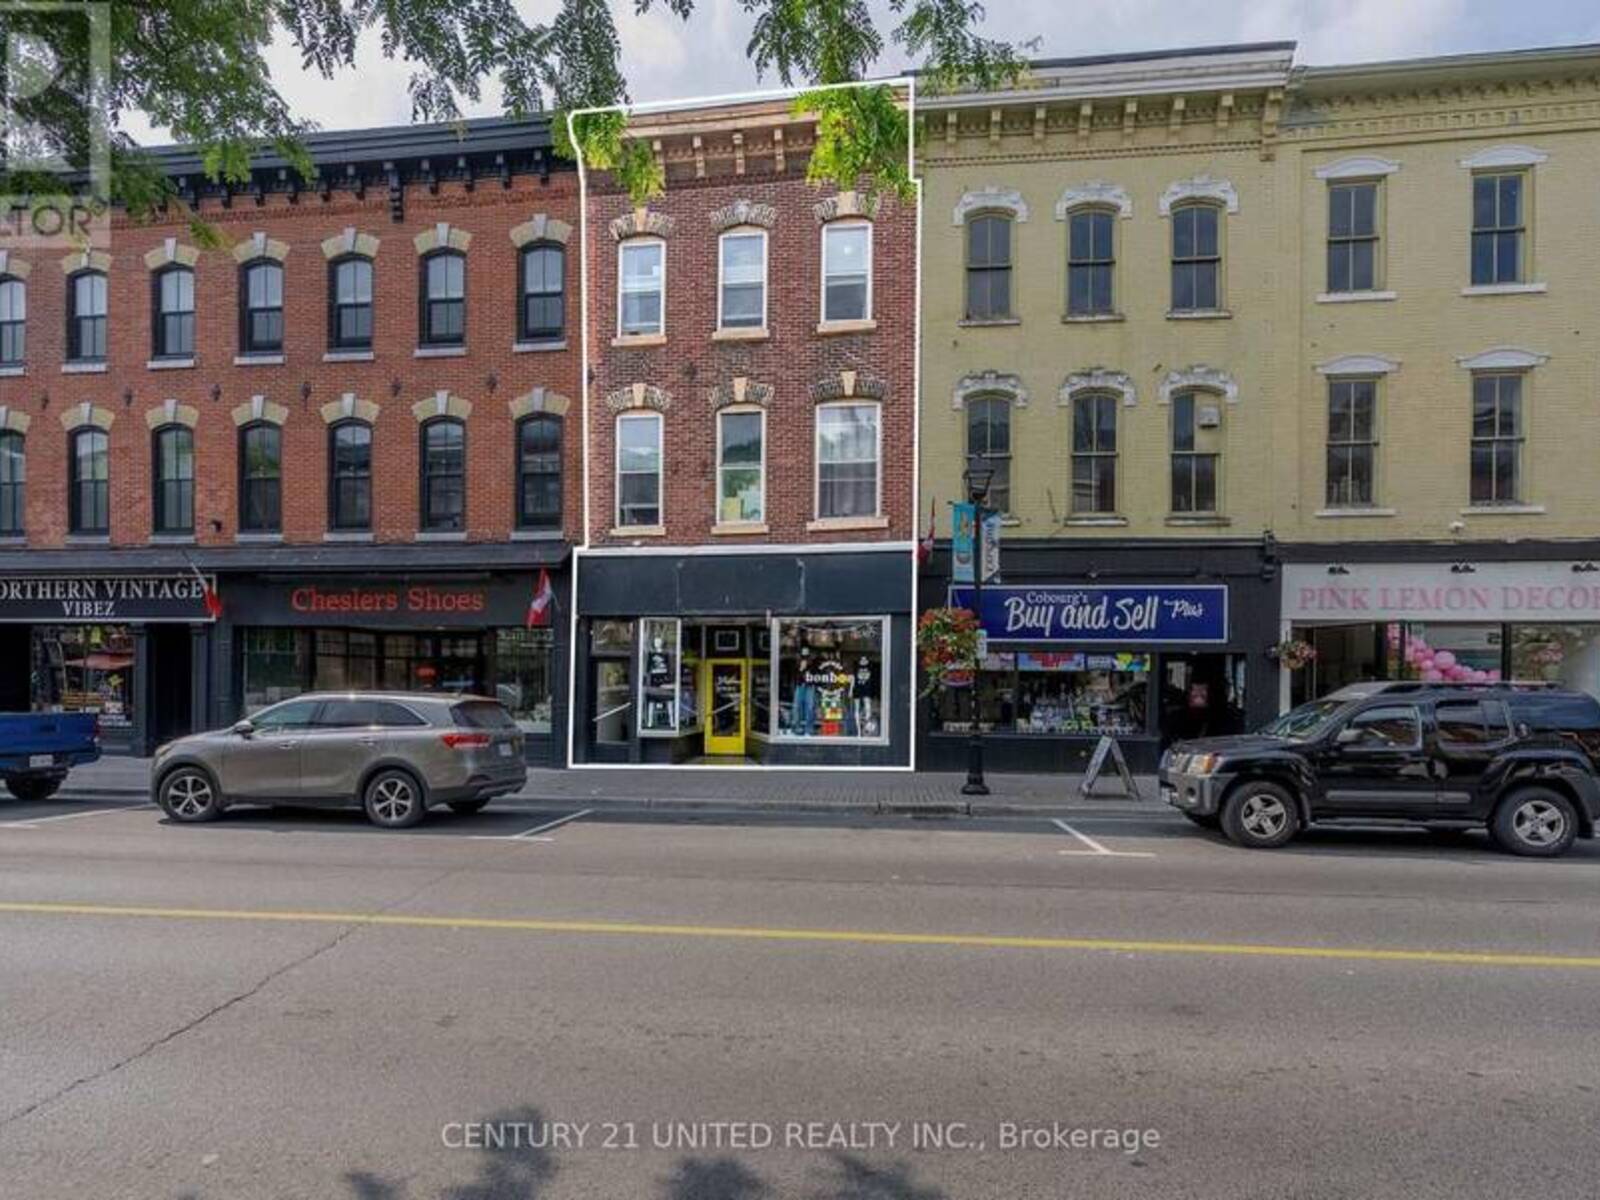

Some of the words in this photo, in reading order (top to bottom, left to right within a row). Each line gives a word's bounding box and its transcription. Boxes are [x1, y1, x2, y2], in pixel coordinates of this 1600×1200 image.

[103, 580, 204, 599] VINTAGE
[407, 585, 485, 611] Shoes
[1025, 590, 1089, 606] Cobourg's
[1299, 586, 1370, 610] PINK
[1376, 586, 1491, 610] LEMON
[62, 600, 115, 617] VIBEZ
[1004, 596, 1053, 638] Buy
[1061, 596, 1110, 630] and
[1113, 595, 1160, 631] Sell
[1164, 598, 1204, 619] Plus
